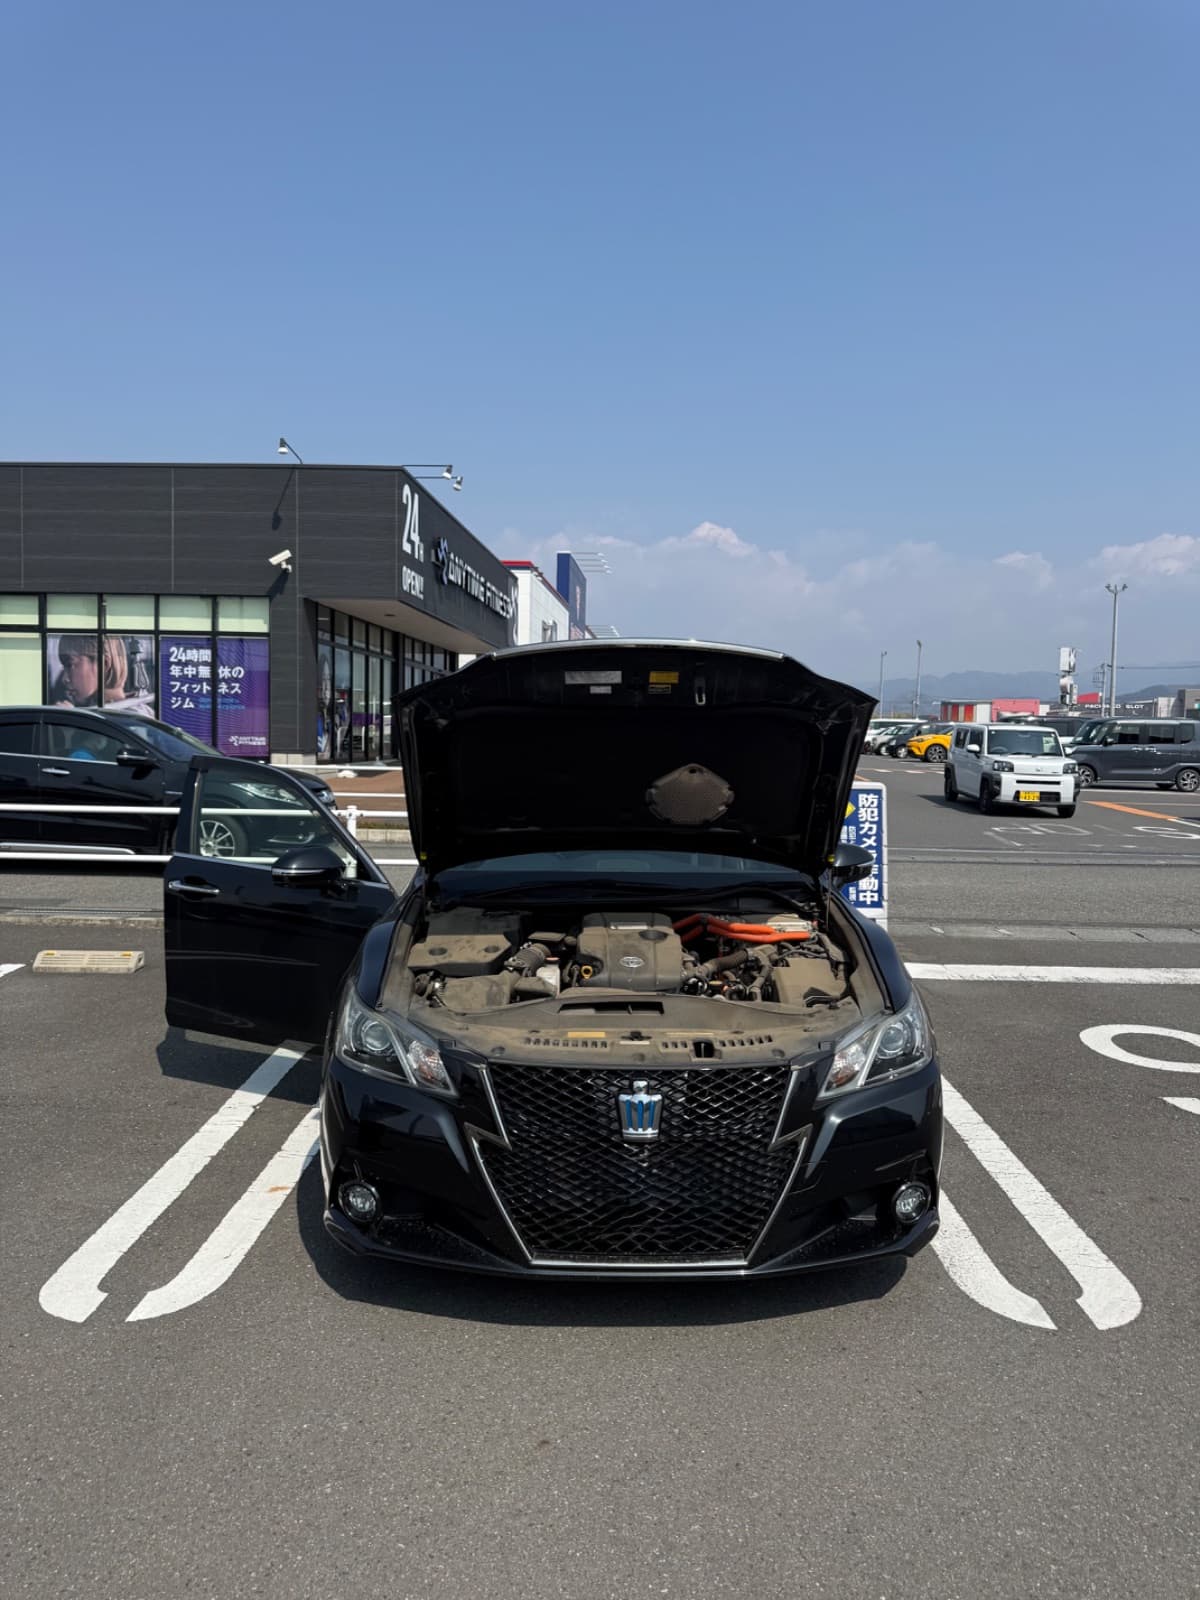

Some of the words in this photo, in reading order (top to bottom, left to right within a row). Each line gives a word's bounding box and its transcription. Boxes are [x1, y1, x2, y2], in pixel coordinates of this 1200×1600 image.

[169, 647, 212, 662] 24時間
[169, 664, 245, 679] 年中無休の
[169, 681, 242, 694] フィットネス
[170, 697, 195, 709] ジム
